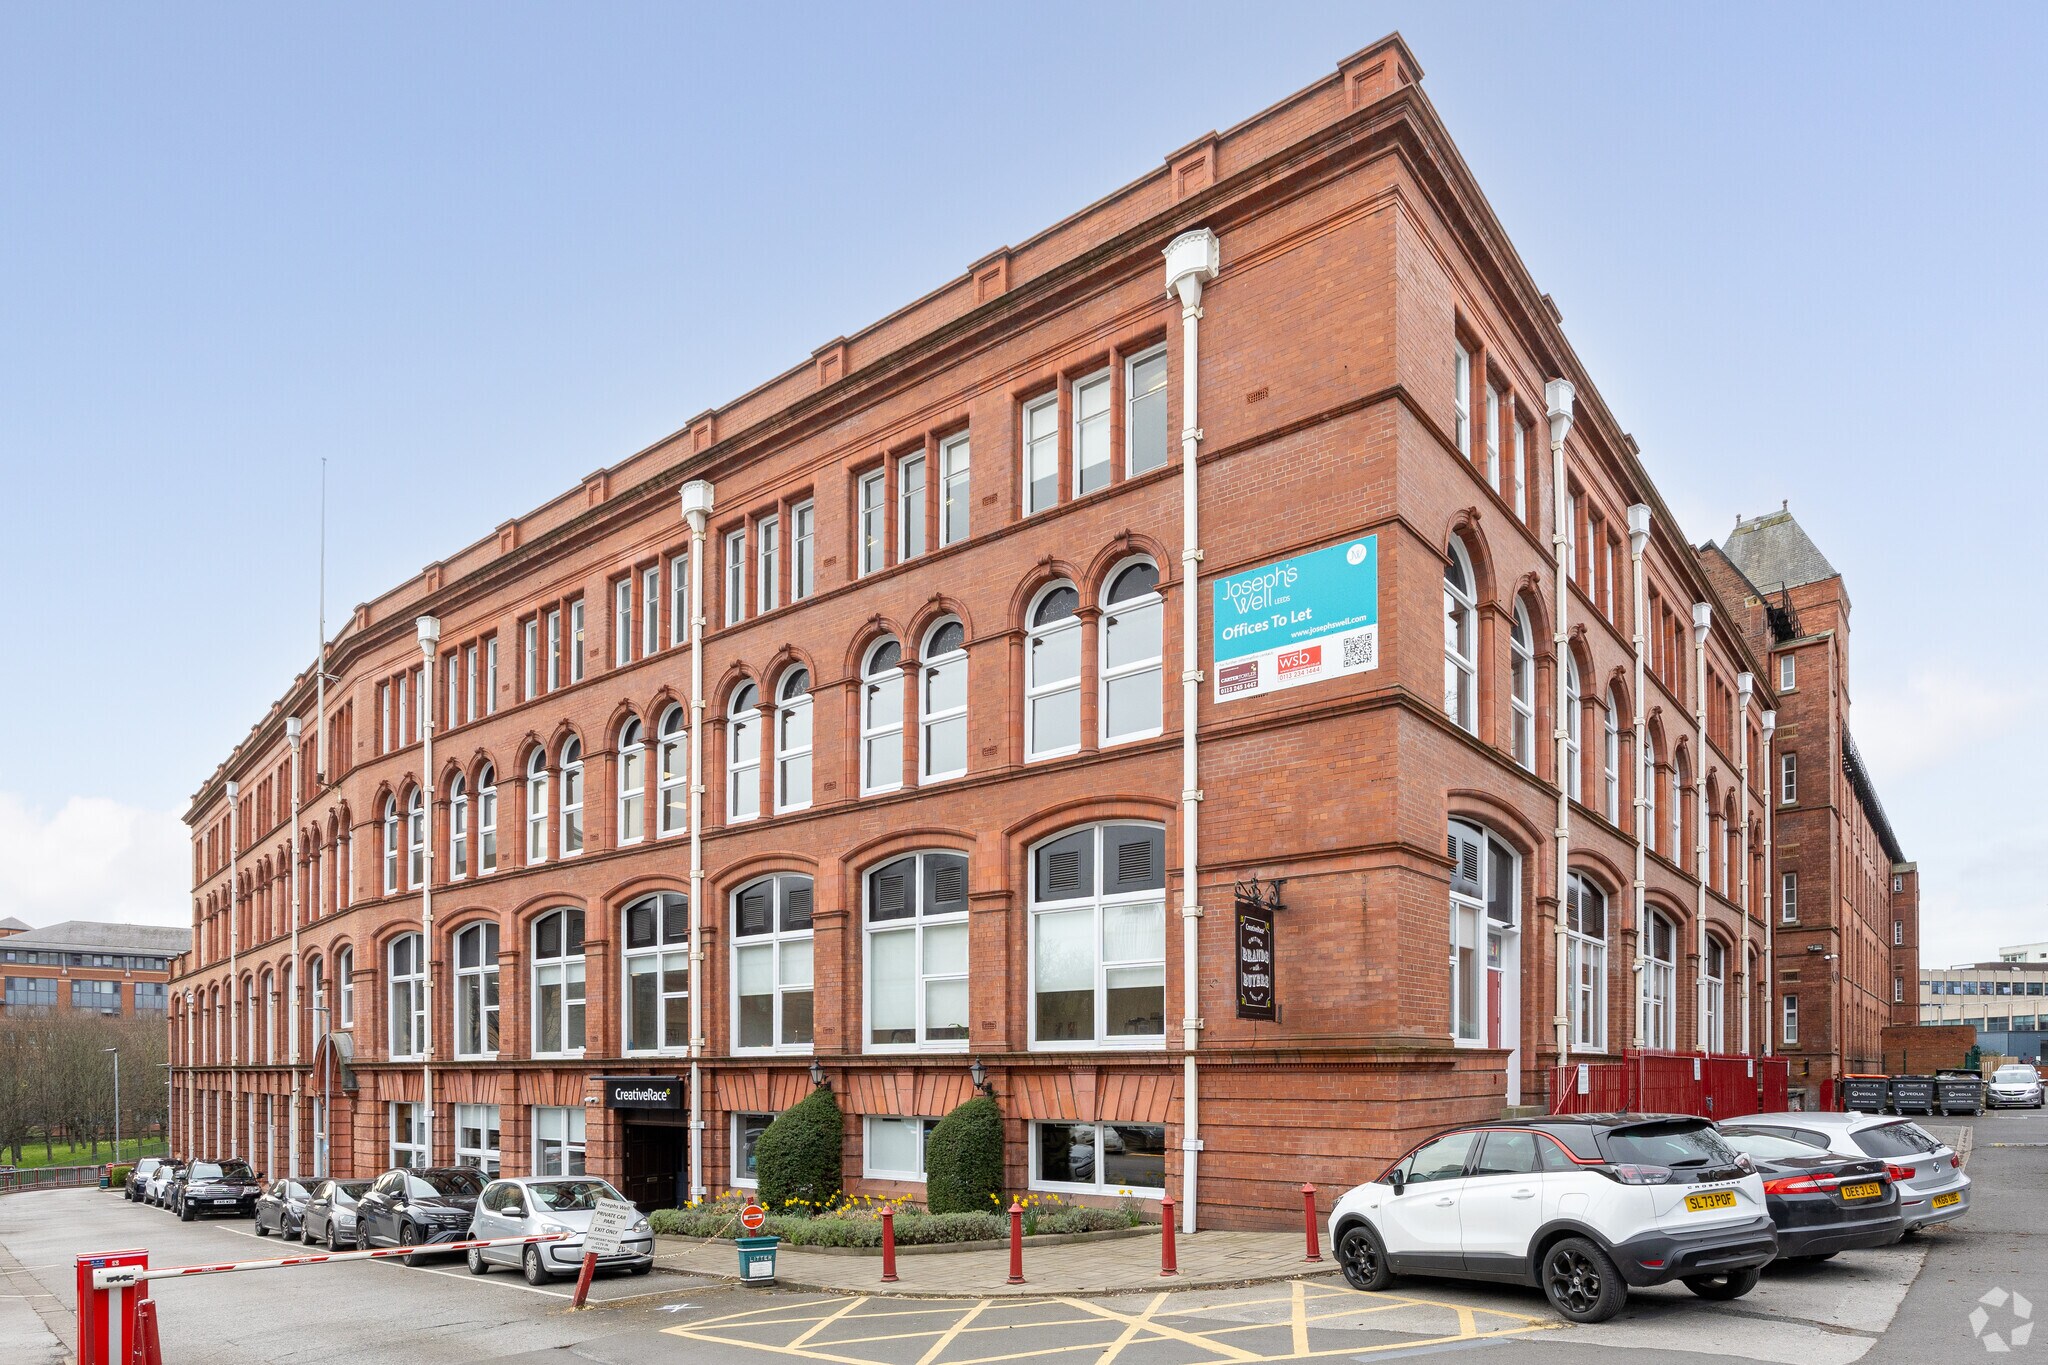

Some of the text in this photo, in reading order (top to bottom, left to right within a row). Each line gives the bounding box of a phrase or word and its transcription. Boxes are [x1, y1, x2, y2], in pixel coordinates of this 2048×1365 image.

[1222, 564, 1298, 600] Joseph's
[1233, 587, 1291, 614] Well LEEDS
[1222, 607, 1312, 640] Offices To Let
[1291, 615, 1367, 638] www.josephswell.com
[1279, 649, 1310, 668] wsb
[1242, 947, 1269, 964] BRANDS
[1242, 972, 1269, 988] BUYERS
[615, 1088, 667, 1101] CreativeRace
[1688, 1180, 1740, 1189] CROSSLAND
[600, 1201, 618, 1209] Josephs
[1690, 1193, 1731, 1209] SL73 POF
